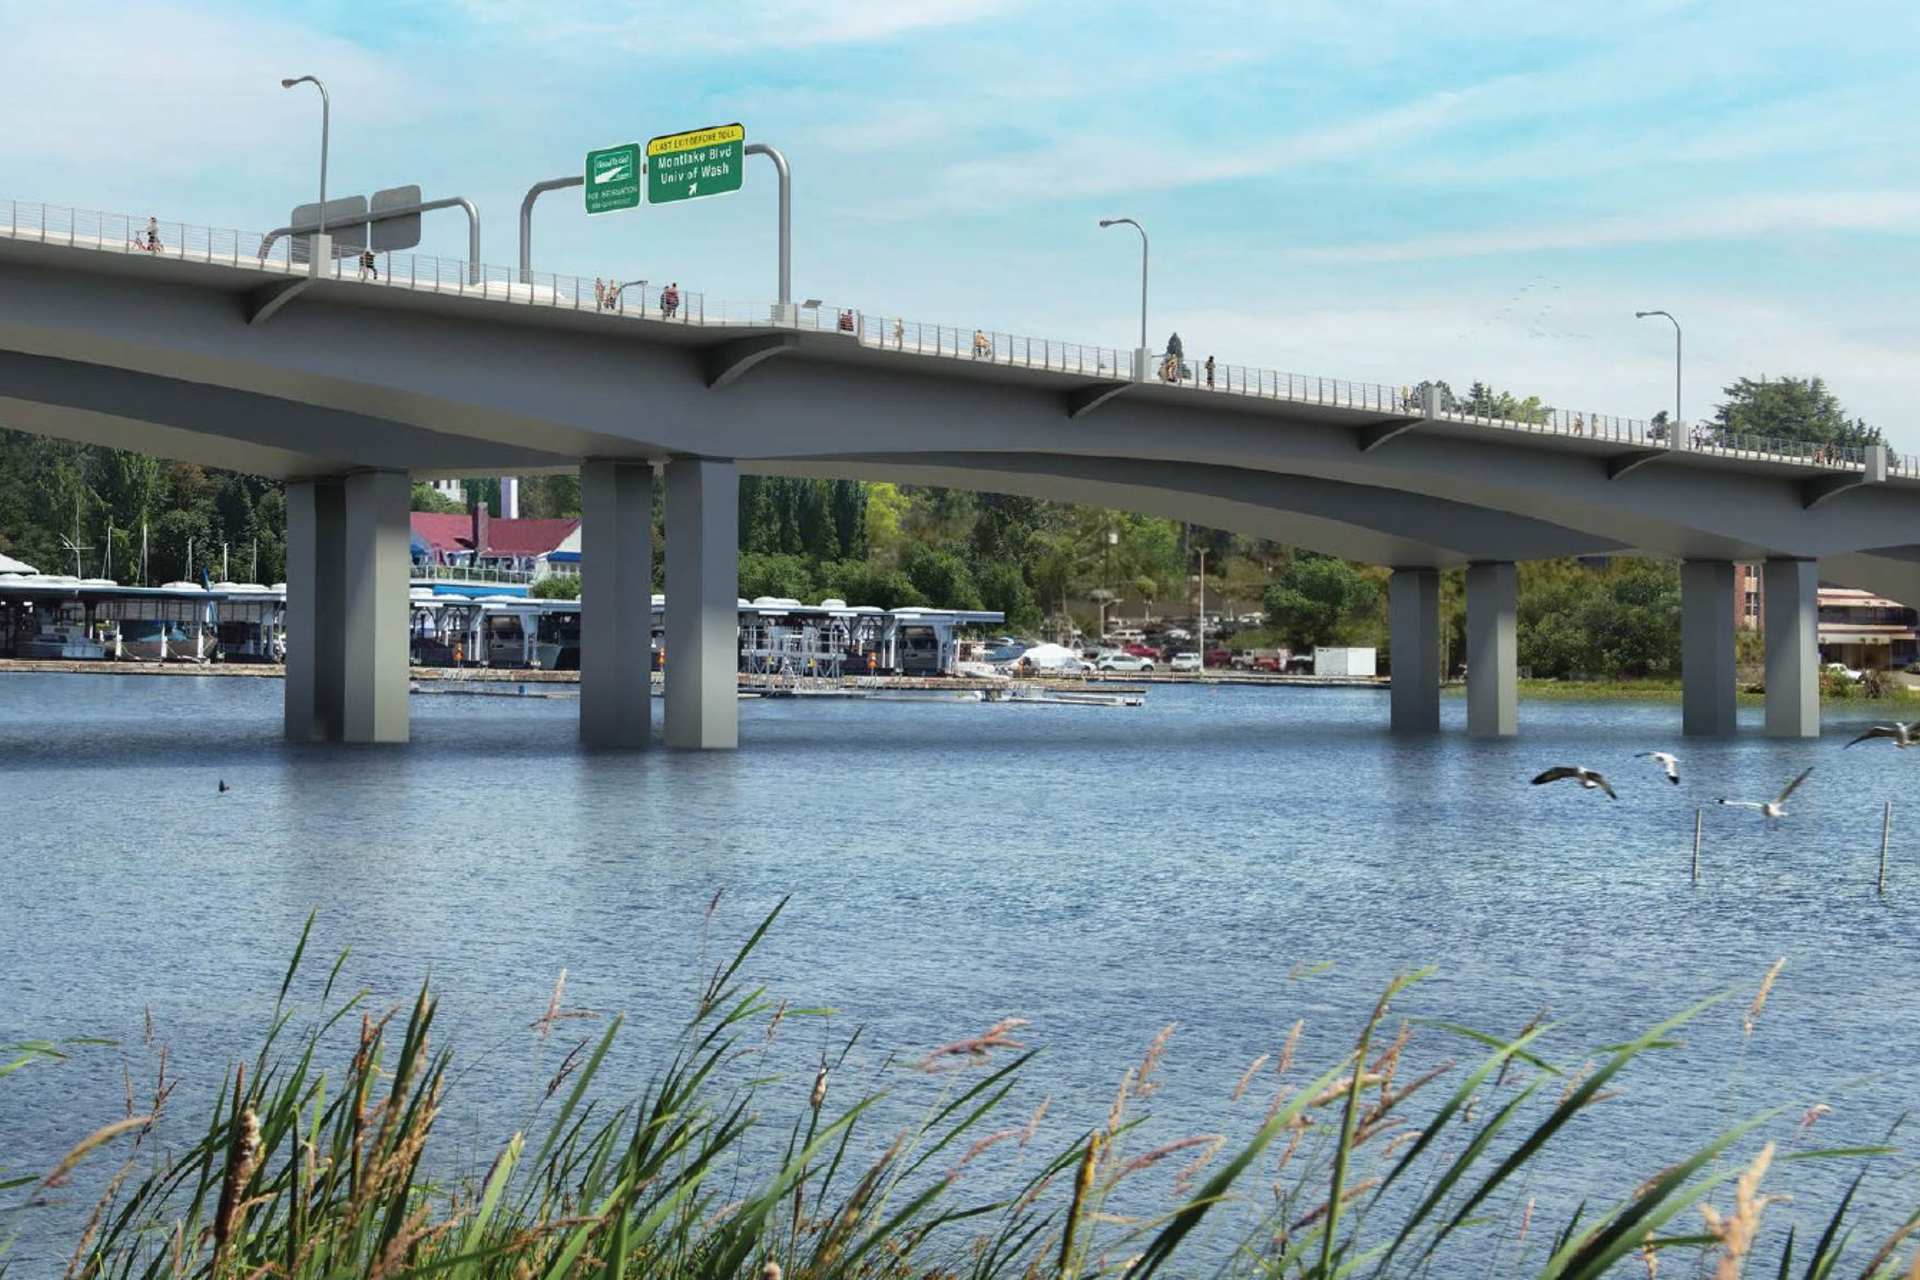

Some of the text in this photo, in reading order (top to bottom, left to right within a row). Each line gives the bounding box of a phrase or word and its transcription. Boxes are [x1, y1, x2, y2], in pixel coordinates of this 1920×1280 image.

[656, 130, 735, 151] LAST EXIT BEFORE TOLL
[658, 145, 732, 168] Montlake Blvd
[661, 162, 729, 184] Univ of Wash
